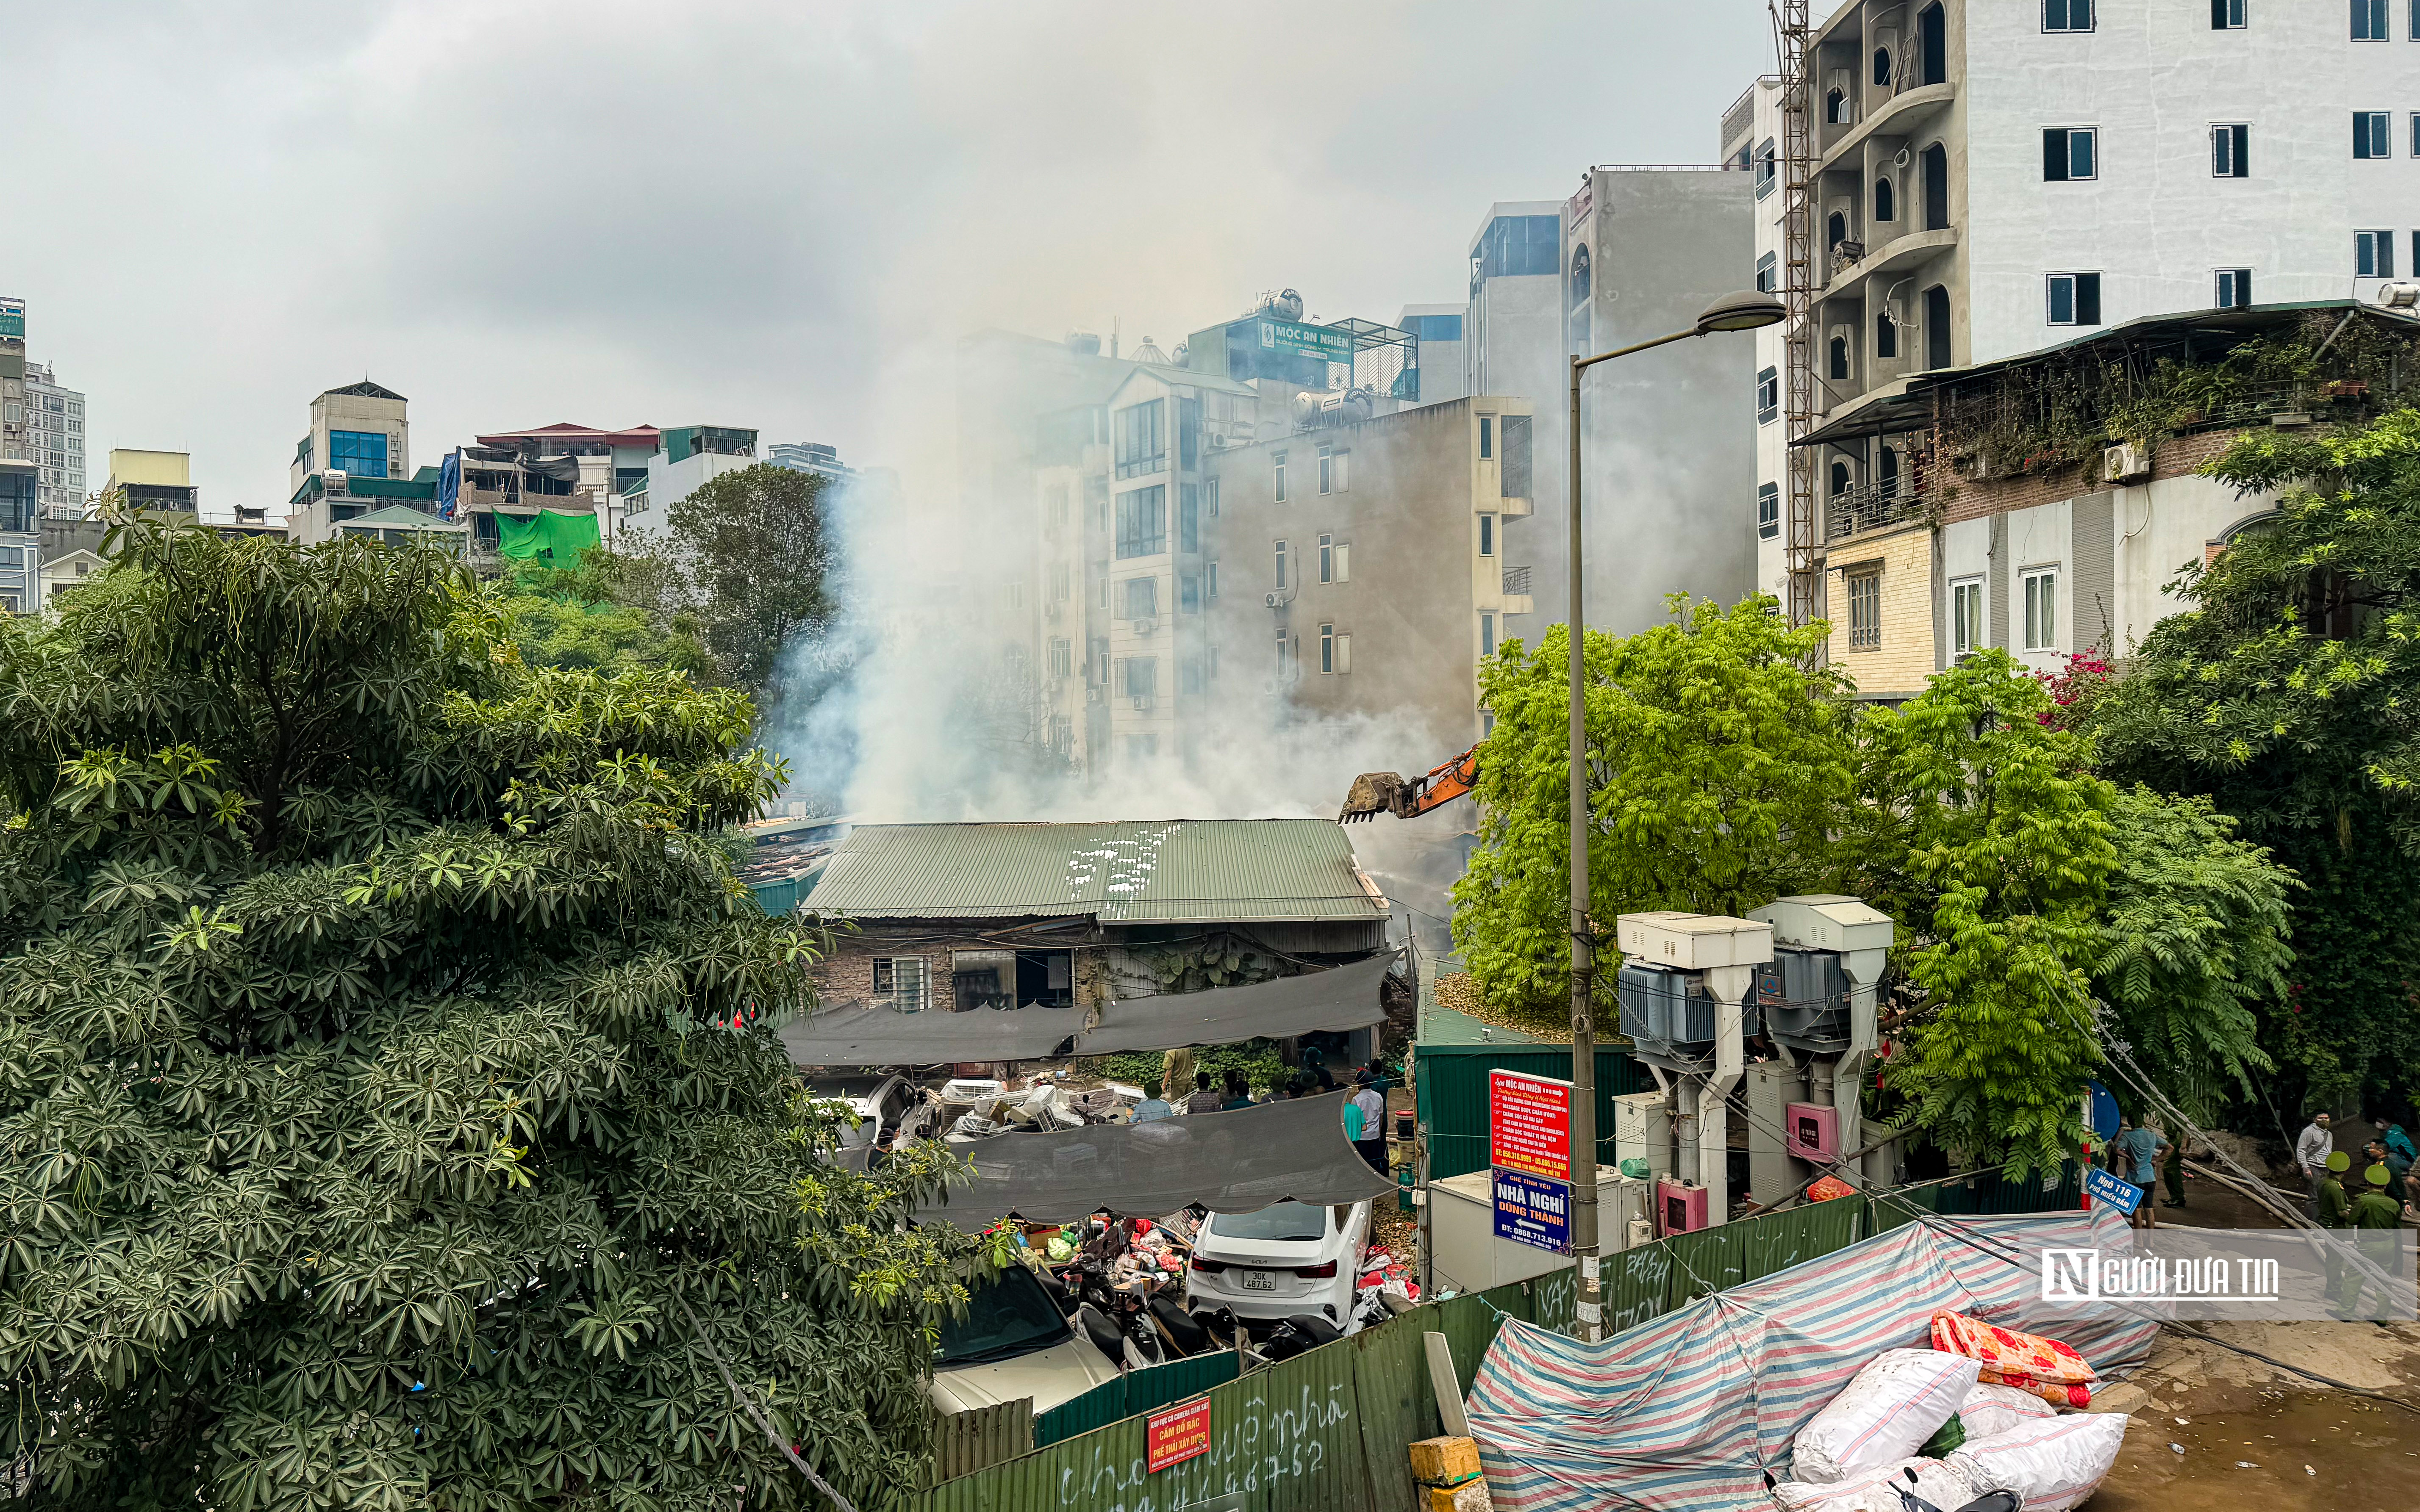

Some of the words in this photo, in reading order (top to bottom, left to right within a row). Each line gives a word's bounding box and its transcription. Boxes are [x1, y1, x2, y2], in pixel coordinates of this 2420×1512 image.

[1276, 326, 1300, 340] MỘC
[1304, 332, 1317, 342] AN
[1320, 335, 1349, 348] NHIÊN
[1495, 1078, 1505, 1088] Spa
[1506, 1079, 1517, 1090] MỘC
[1518, 1081, 1525, 1091] AN
[1526, 1083, 1541, 1094] NHIÊN
[1502, 1103, 1521, 1112] MASSAGE
[1543, 1111, 1556, 1119] (FOOT)
[1524, 1178, 1537, 1187] TÌNH
[2097, 1175, 2114, 1189] Ngõ
[2115, 1184, 2131, 1197] 116
[1497, 1182, 1526, 1205] NHÀ
[1530, 1191, 1564, 1215] NGHỈ
[2089, 1184, 2102, 1193] PHỐ
[2101, 1190, 2116, 1202] MIẾU
[1529, 1209, 1564, 1227] THÀNH
[1501, 1224, 1512, 1233] ĐT:
[1514, 1227, 1561, 1246] 0868.713.916
[1247, 1280, 1272, 1289] 487.62
[1151, 1420, 1159, 1429] KHU
[1168, 1414, 1174, 1423] CÓ
[1174, 1409, 1190, 1421] CAMERA
[1159, 1426, 1174, 1440] CẤM
[1176, 1419, 1185, 1434] ĐỔ
[1187, 1417, 1200, 1431] RÁC
[1153, 1444, 1164, 1459] PHẾ
[1166, 1440, 1178, 1455] THẢI
[1179, 1437, 1191, 1450] XÂY
